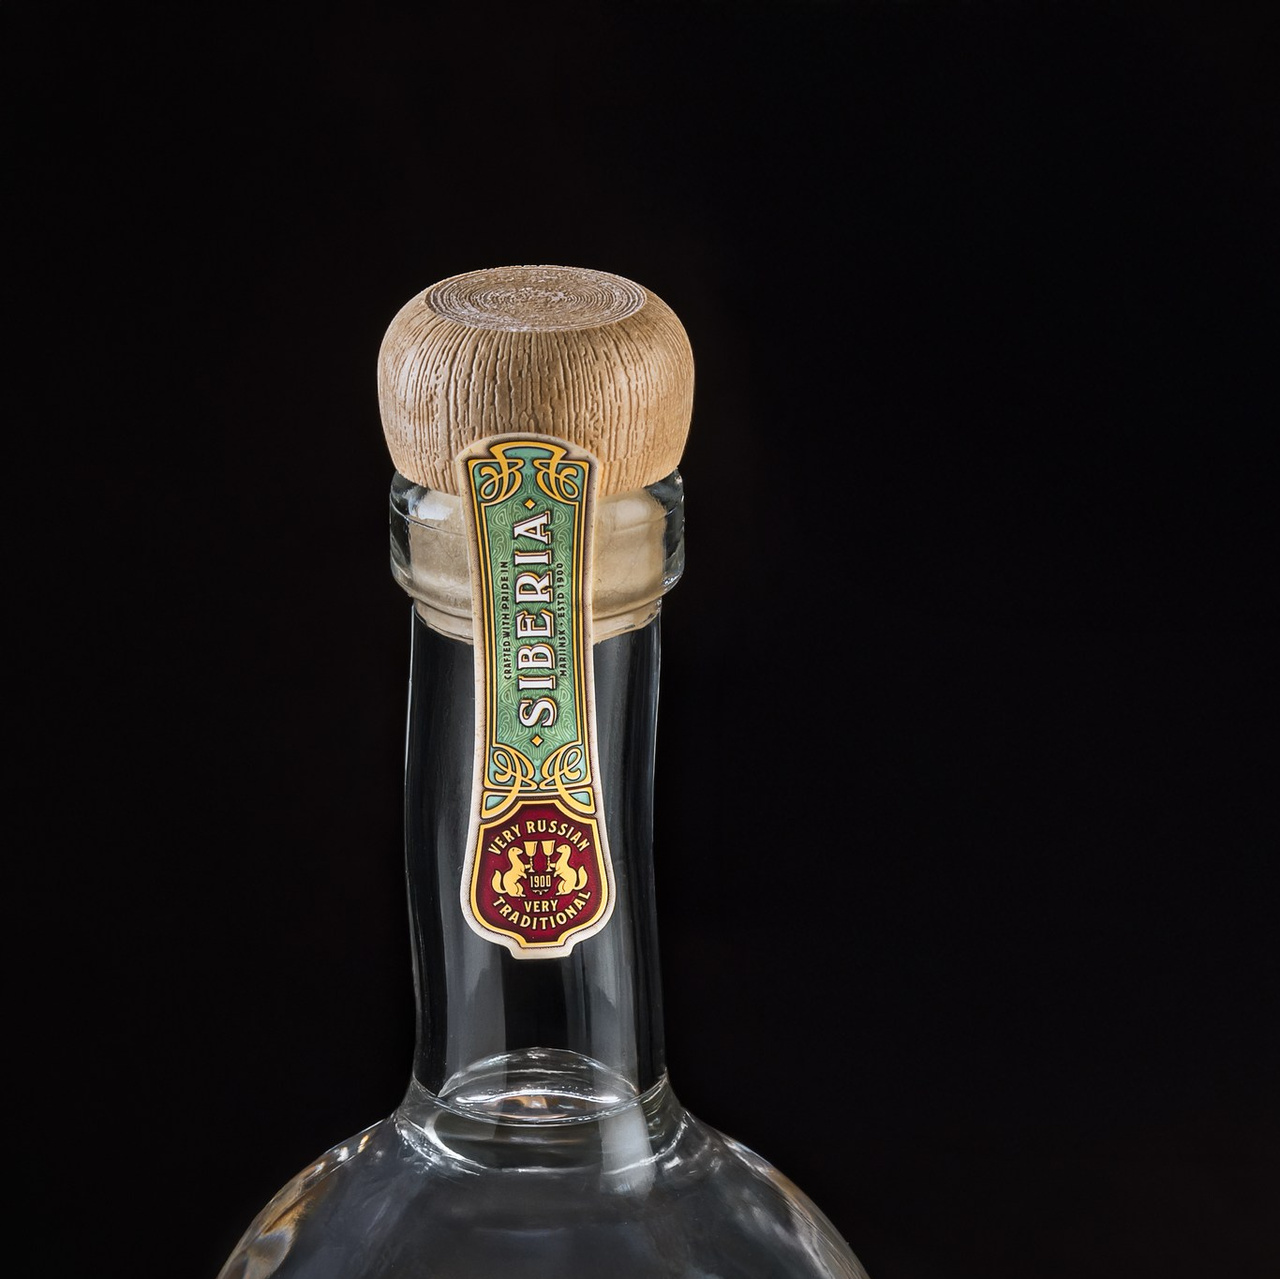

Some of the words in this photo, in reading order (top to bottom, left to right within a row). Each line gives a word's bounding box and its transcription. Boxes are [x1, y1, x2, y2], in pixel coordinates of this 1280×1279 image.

[502, 561, 508, 574] IN
[502, 575, 510, 610] PRIDE
[503, 611, 511, 639] WITH
[513, 510, 558, 728] SIBERIA
[504, 640, 512, 680] CRAFTED
[558, 630, 568, 677] MARIINSK
[488, 824, 521, 855] VERY
[526, 820, 591, 852] RUSSIAN
[530, 875, 551, 887] 1900
[493, 892, 591, 929] TRADITIONAL
[524, 900, 558, 912] VERY
